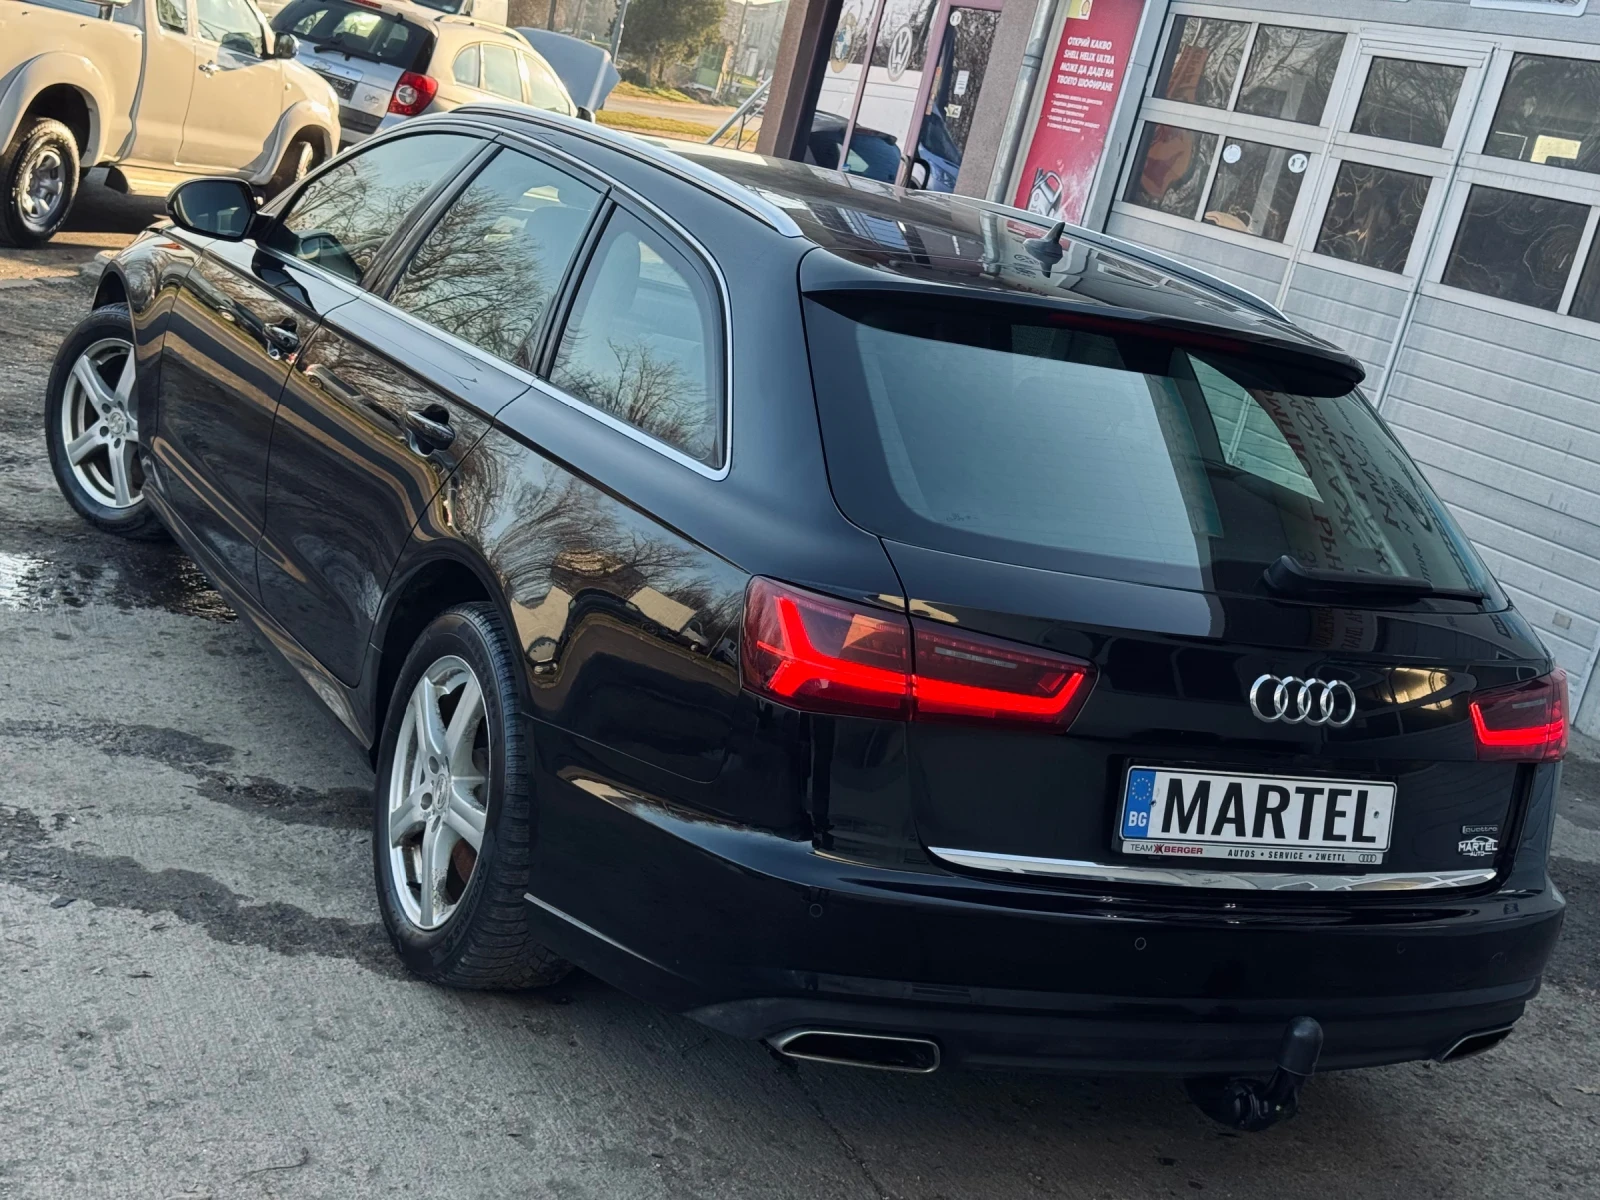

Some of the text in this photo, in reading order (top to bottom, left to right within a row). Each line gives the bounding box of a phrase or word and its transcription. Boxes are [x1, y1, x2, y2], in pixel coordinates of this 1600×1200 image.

[1067, 36, 1112, 50] ОТКРИЙ КАКВО
[1063, 49, 1115, 64] SHELL HELIX ULTRA
[1060, 62, 1115, 78] МОЖЕ ДА ДАДЕ НА
[1057, 75, 1115, 92] ТВОЕТО ШОФИРАНЕ
[1128, 777, 1377, 843] BG MARTEL
[1130, 843, 1204, 855] TEAM BERGER
[1458, 841, 1498, 852] MARTEL
[1227, 849, 1346, 862] AUTOS SERVICE ZWETTL
